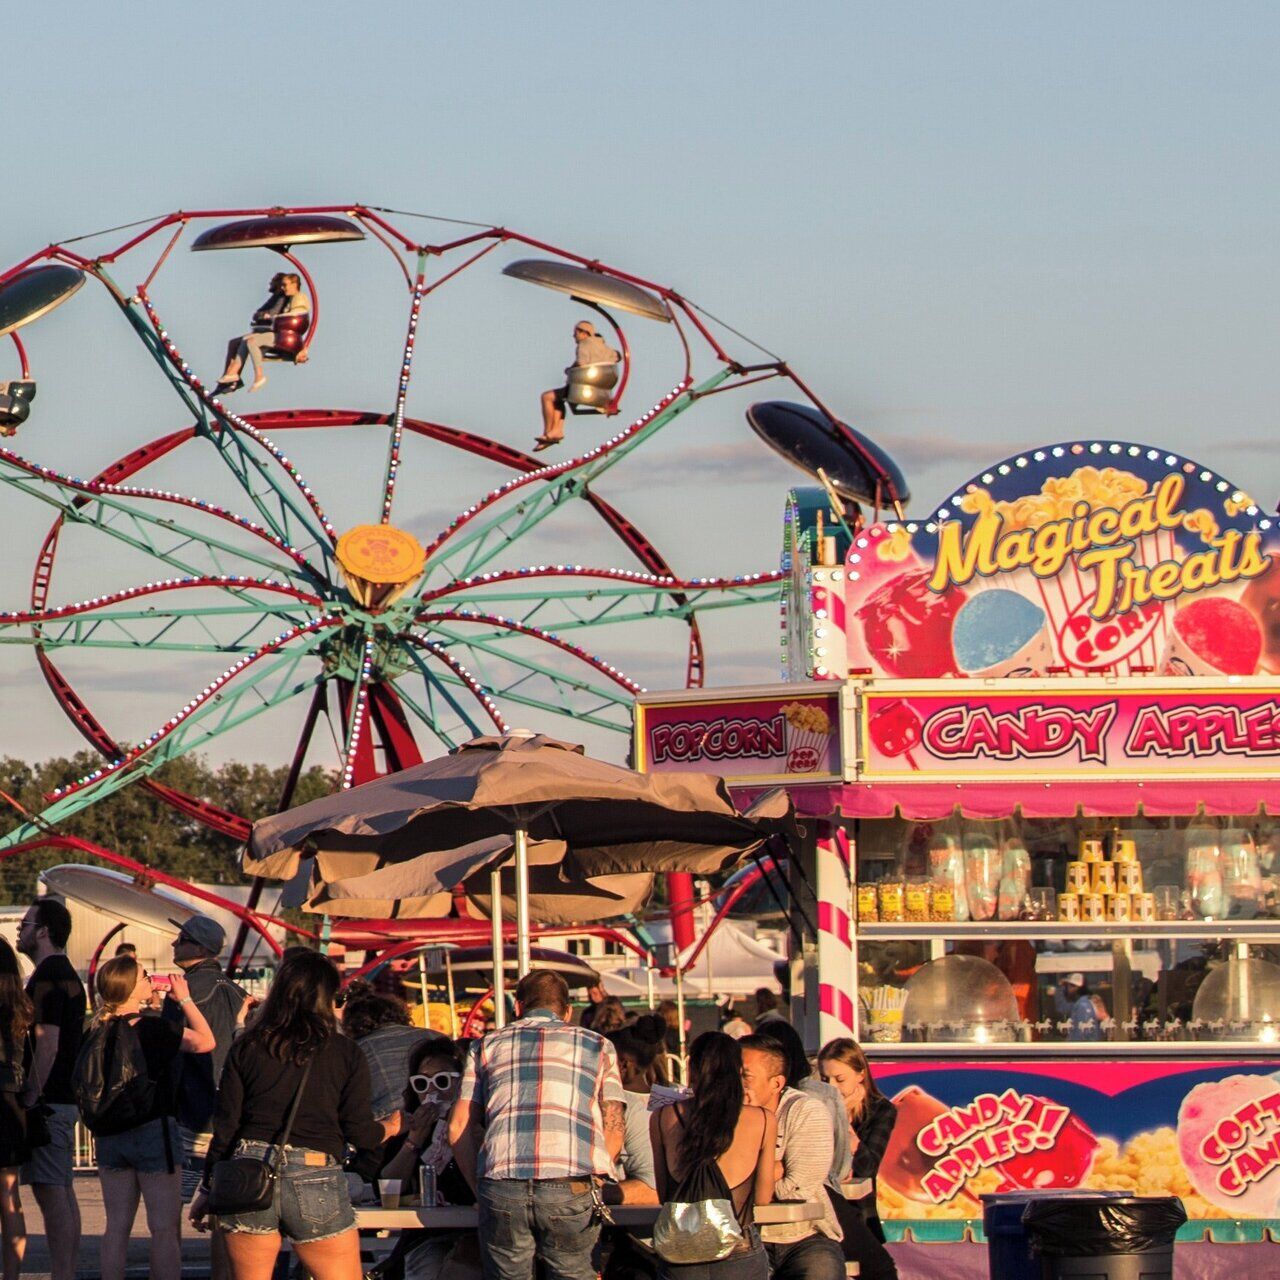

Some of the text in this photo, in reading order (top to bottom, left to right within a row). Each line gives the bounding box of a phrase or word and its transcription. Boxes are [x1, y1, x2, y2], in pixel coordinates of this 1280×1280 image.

[926, 471, 1187, 594] Magical
[1077, 527, 1274, 621] Treats
[651, 713, 787, 764] POPCORN
[921, 699, 1119, 765] CANDY
[916, 1088, 1034, 1157] CANDY
[920, 1106, 1071, 1204] APPLES!
